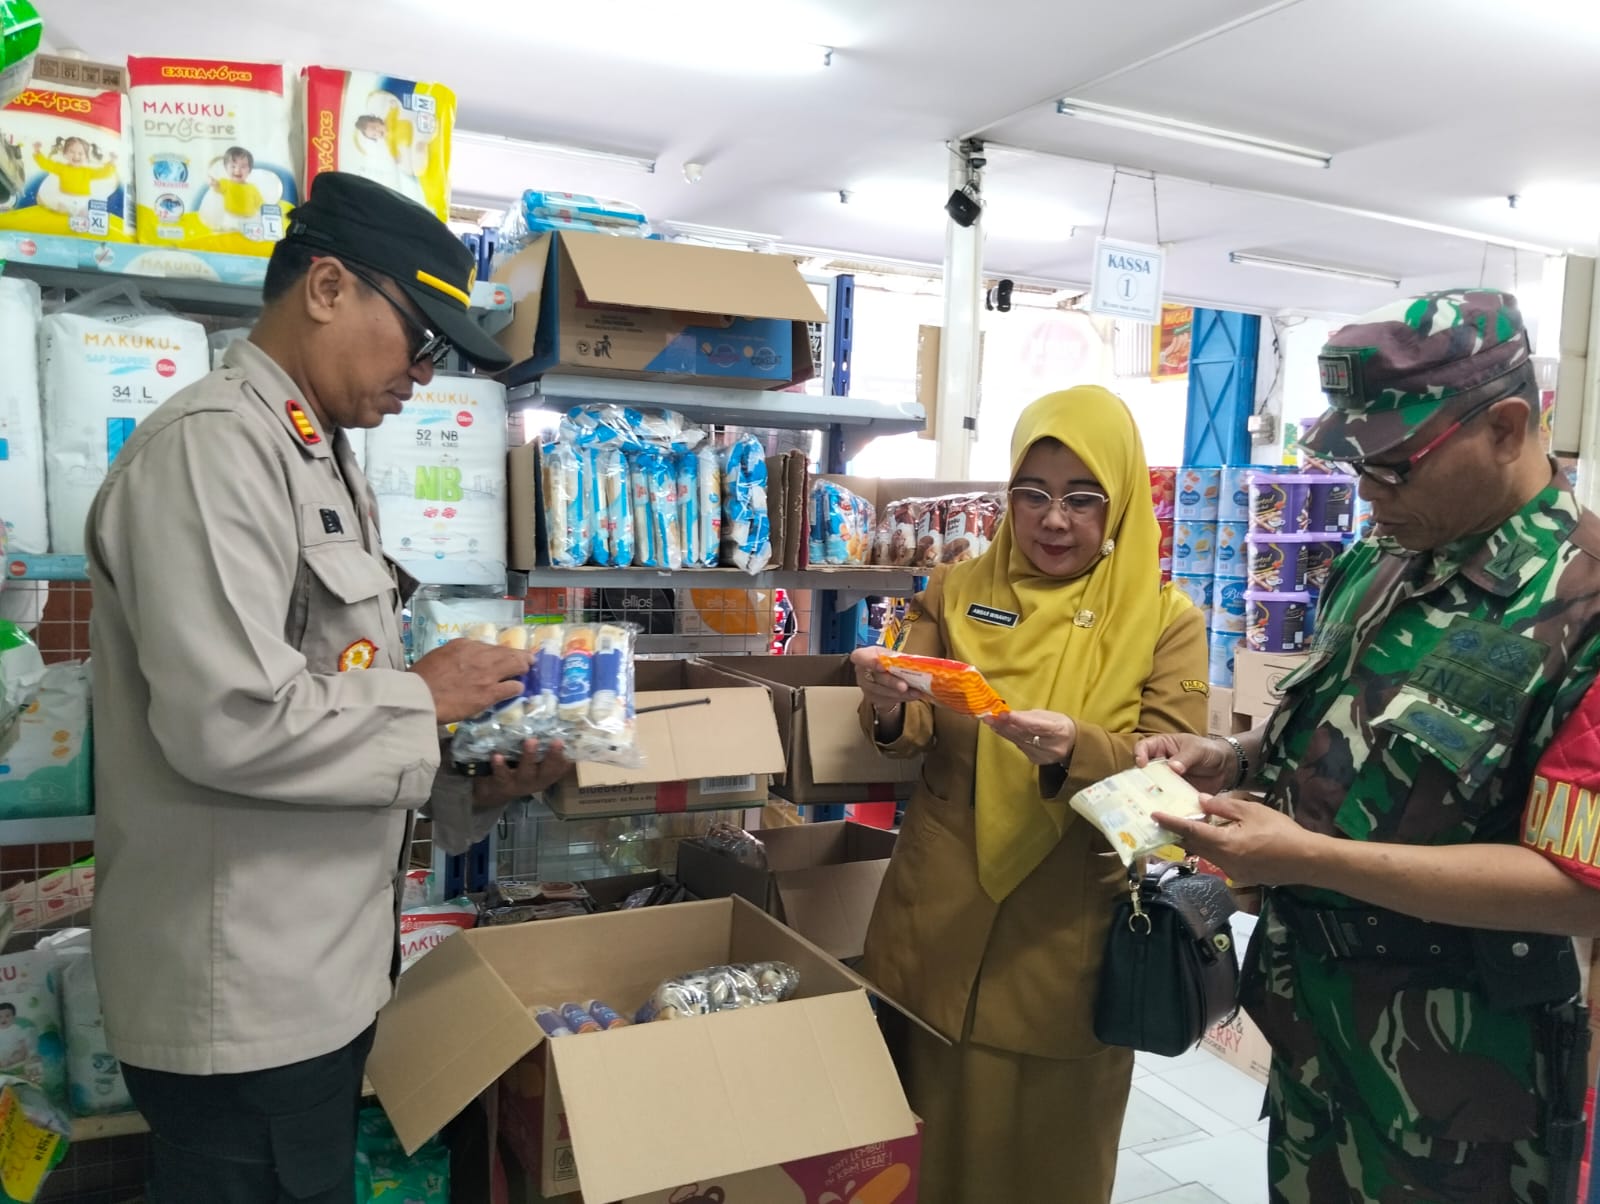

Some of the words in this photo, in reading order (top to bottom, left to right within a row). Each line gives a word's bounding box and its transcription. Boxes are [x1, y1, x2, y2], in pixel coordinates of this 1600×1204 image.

[143, 101, 225, 117] MAKUKU
[144, 119, 176, 134] Dry
[91, 217, 105, 228] XL
[268, 223, 277, 233] L
[1108, 254, 1150, 274] KASSA
[1124, 279, 1131, 297] 1
[84, 333, 171, 350] MAKUKU
[112, 386, 130, 398] 34
[143, 386, 153, 399] L
[413, 391, 469, 405] AKUKU
[415, 429, 432, 441] 52
[440, 430, 459, 442] NB
[416, 466, 463, 501] NB
[622, 594, 653, 609] ellips
[1417, 664, 1463, 696] TNI
[1526, 775, 1600, 868] DAN
